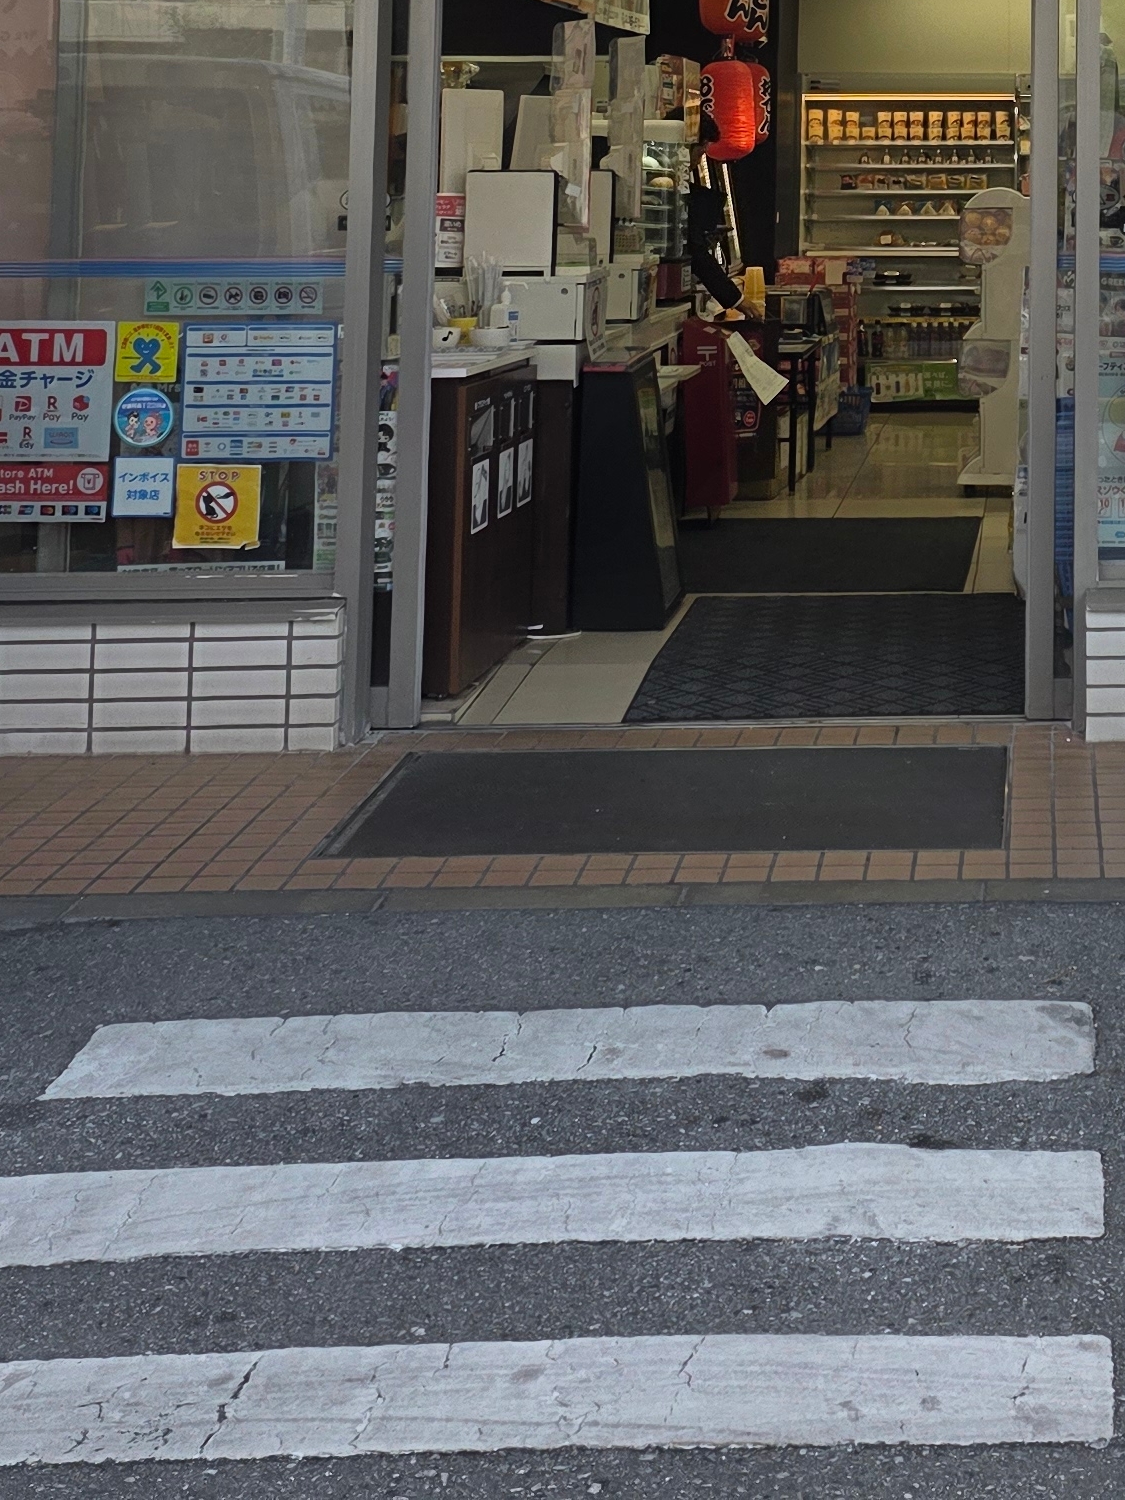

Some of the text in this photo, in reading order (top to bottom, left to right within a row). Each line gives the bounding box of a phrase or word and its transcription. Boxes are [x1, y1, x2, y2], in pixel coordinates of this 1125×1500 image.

[0, 333, 84, 362] ATM
[0, 369, 94, 389] 金チャージ
[43, 413, 61, 422] Pay
[71, 412, 90, 422] Pay
[28, 468, 54, 478] ATM
[118, 472, 170, 483] インボイス
[198, 470, 241, 482] STOP
[30, 480, 73, 494] Here!
[126, 489, 160, 500] 対象店
